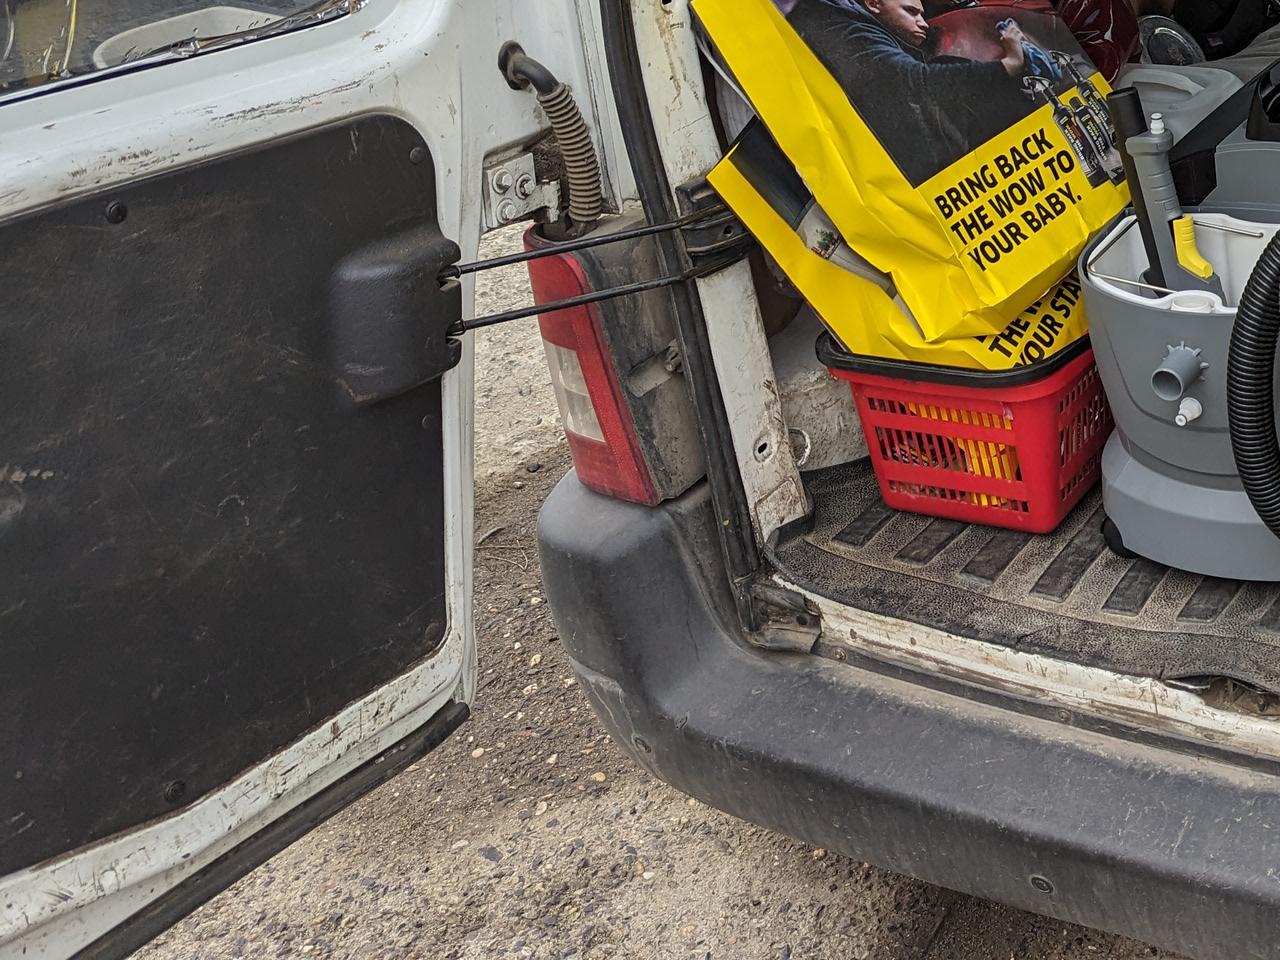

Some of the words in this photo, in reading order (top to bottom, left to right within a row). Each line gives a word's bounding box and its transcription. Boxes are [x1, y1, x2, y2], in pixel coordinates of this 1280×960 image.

[934, 164, 998, 220] BRING
[993, 128, 1054, 179] BACK
[950, 205, 994, 246] THE
[988, 167, 1046, 219] WOW
[1042, 149, 1075, 181] TO
[967, 221, 1029, 272] YOUR
[1020, 182, 1082, 233] BABY.
